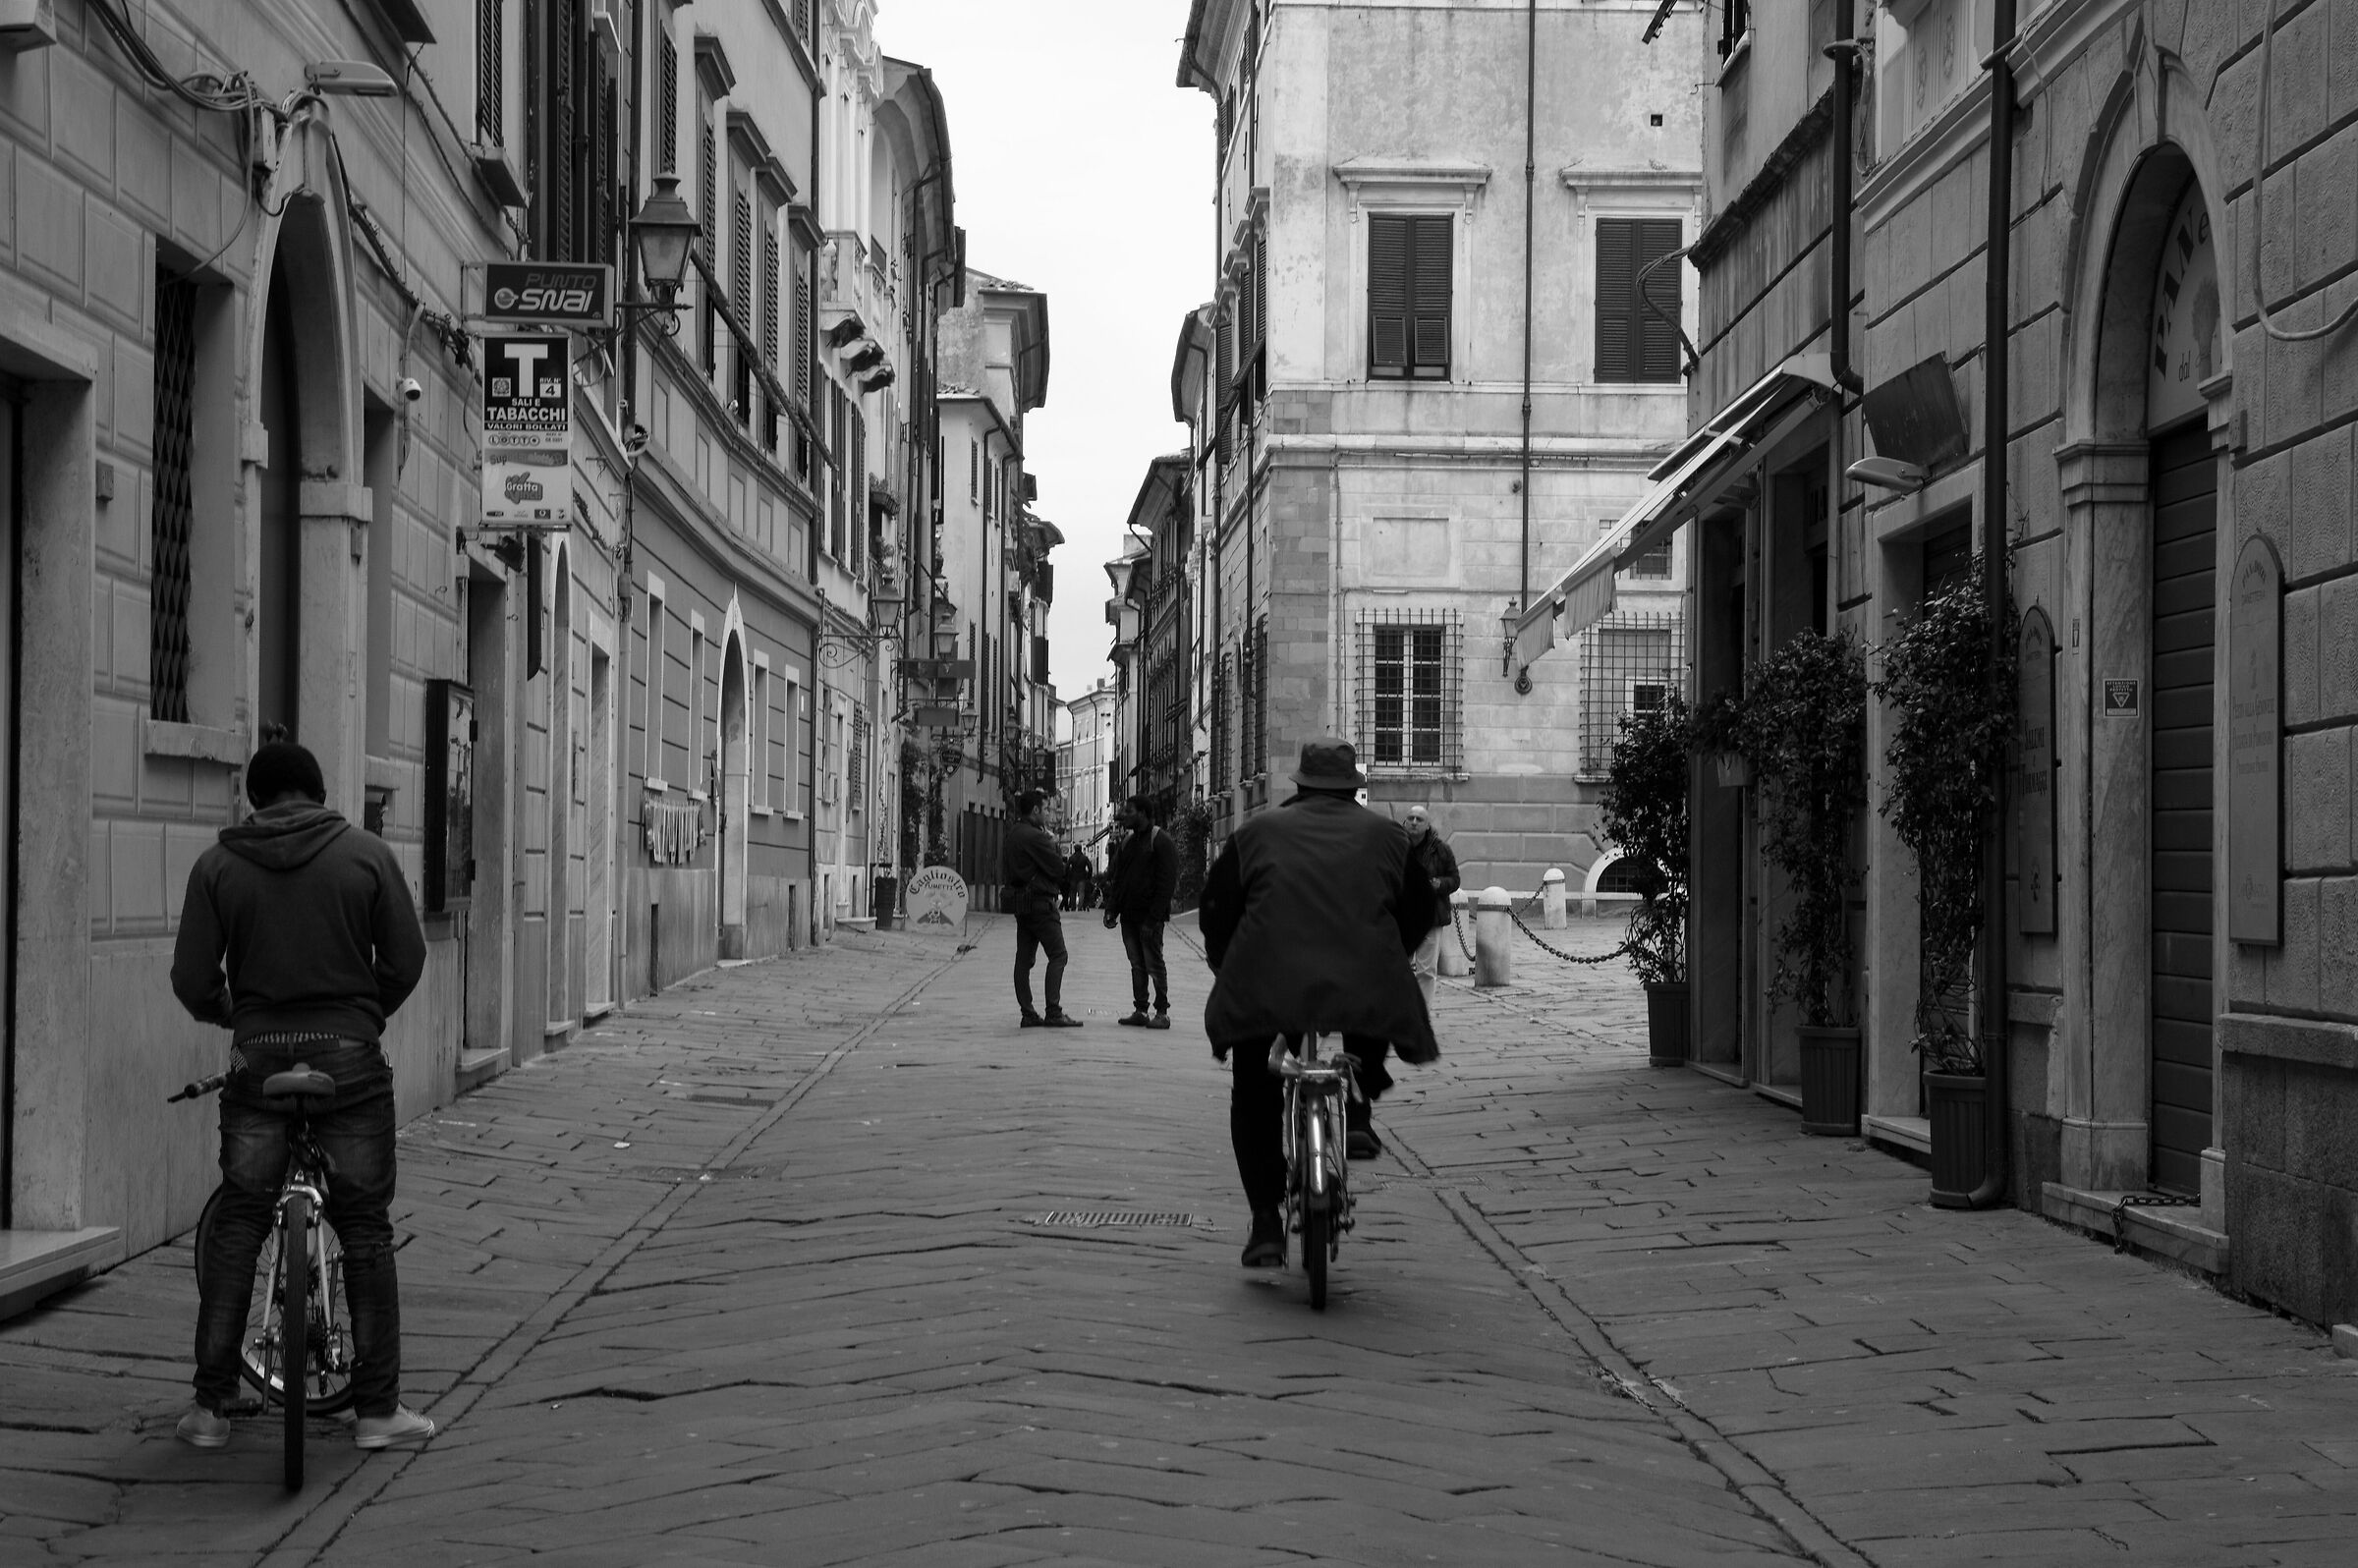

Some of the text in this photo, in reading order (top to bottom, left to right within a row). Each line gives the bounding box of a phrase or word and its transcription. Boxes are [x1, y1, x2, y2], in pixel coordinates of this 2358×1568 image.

[525, 273, 597, 289] PUNTO
[504, 343, 548, 398] T
[545, 385, 555, 396] 4
[512, 398, 540, 407] SALI E
[486, 407, 566, 421] TABACCHI
[506, 481, 538, 492] Gratta
[909, 868, 966, 898] Cagliostro
